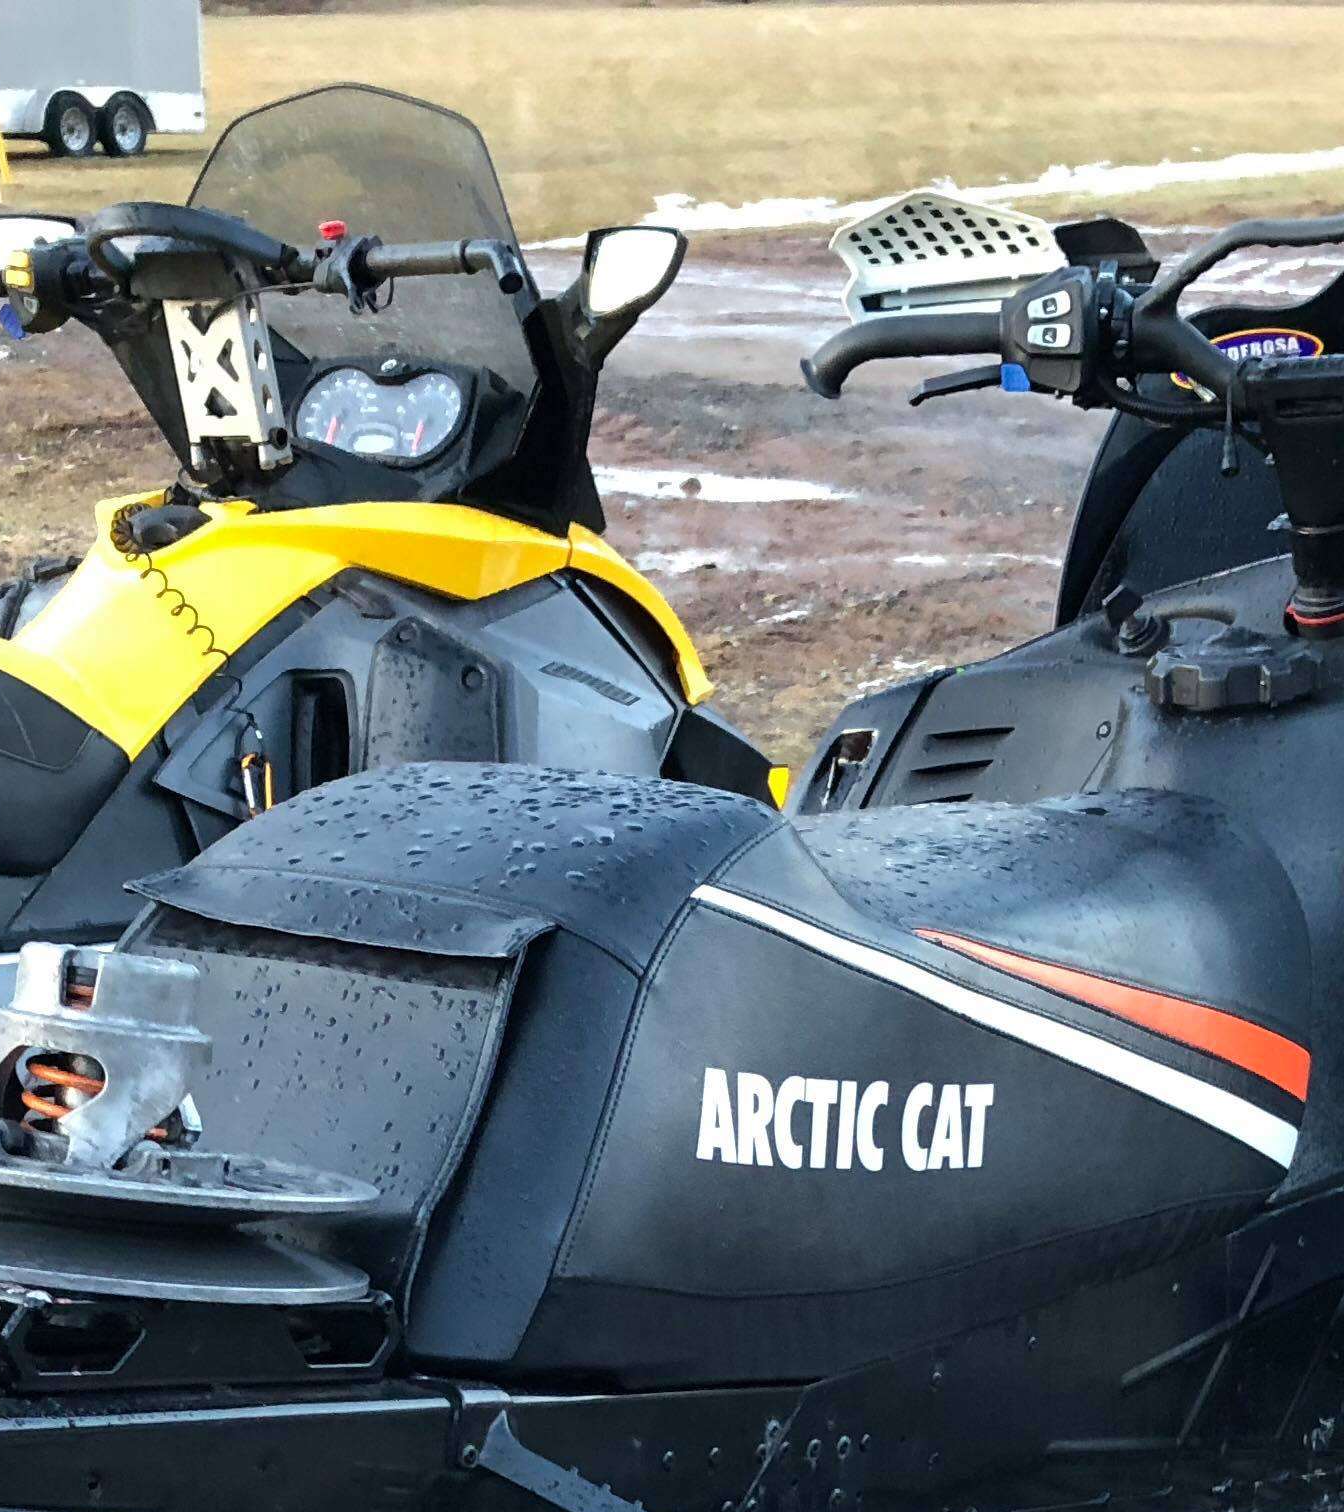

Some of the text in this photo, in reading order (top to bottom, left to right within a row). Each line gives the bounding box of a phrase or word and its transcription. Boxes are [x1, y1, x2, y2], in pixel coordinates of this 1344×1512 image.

[1222, 336, 1300, 361] DEROSA
[696, 1067, 995, 1172] ARCTIC CAT
